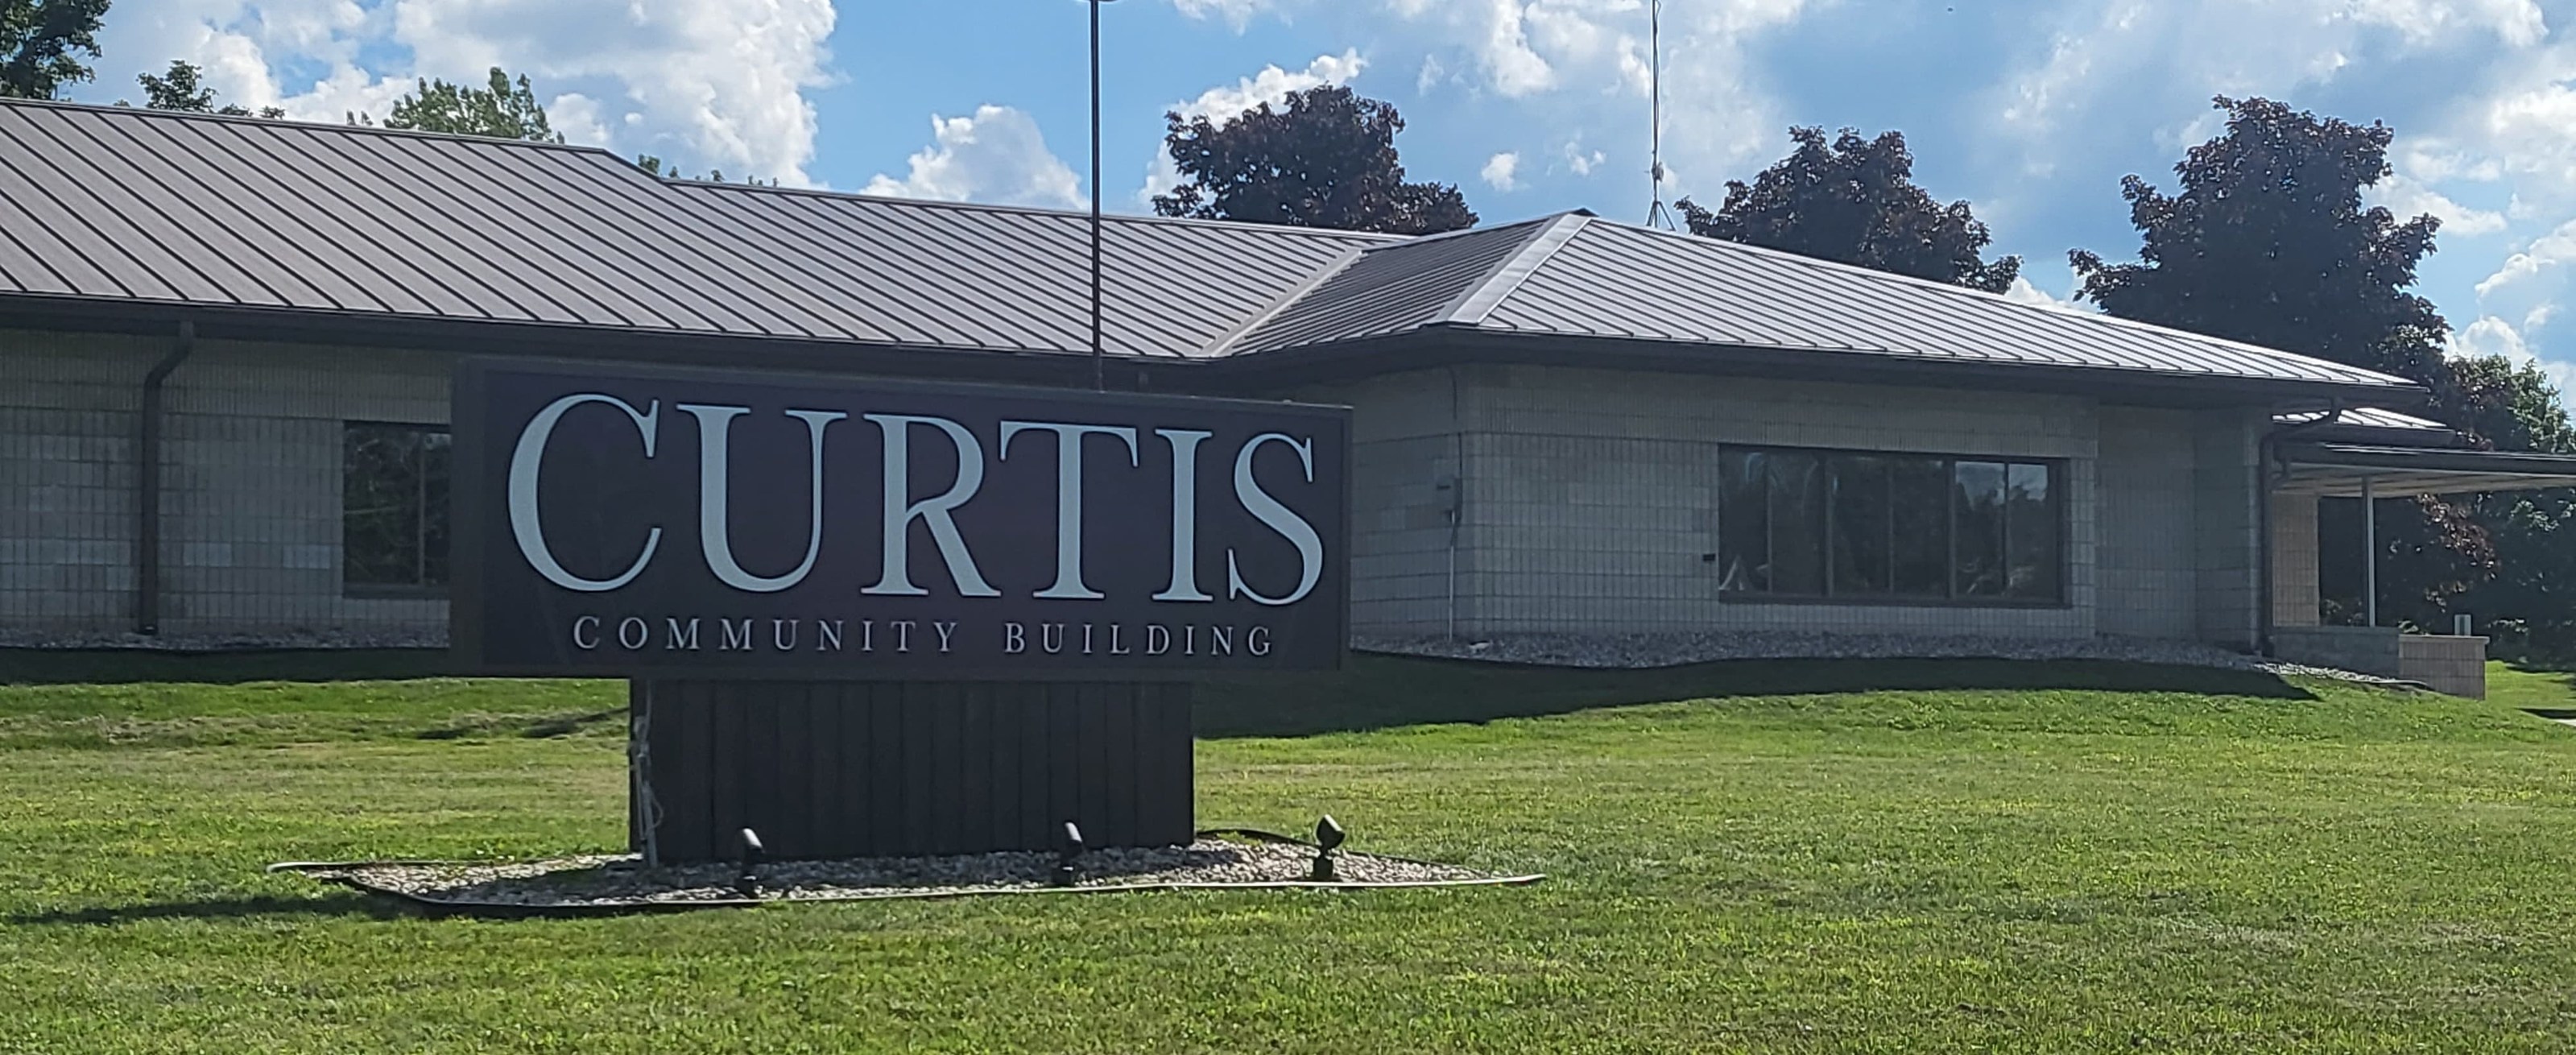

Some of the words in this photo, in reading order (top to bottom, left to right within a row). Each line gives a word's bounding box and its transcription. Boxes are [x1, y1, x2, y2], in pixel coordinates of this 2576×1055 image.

[507, 393, 1324, 606] CURTIS
[573, 615, 960, 652] COMMUNITY
[1003, 623, 1275, 656] BUILDING
